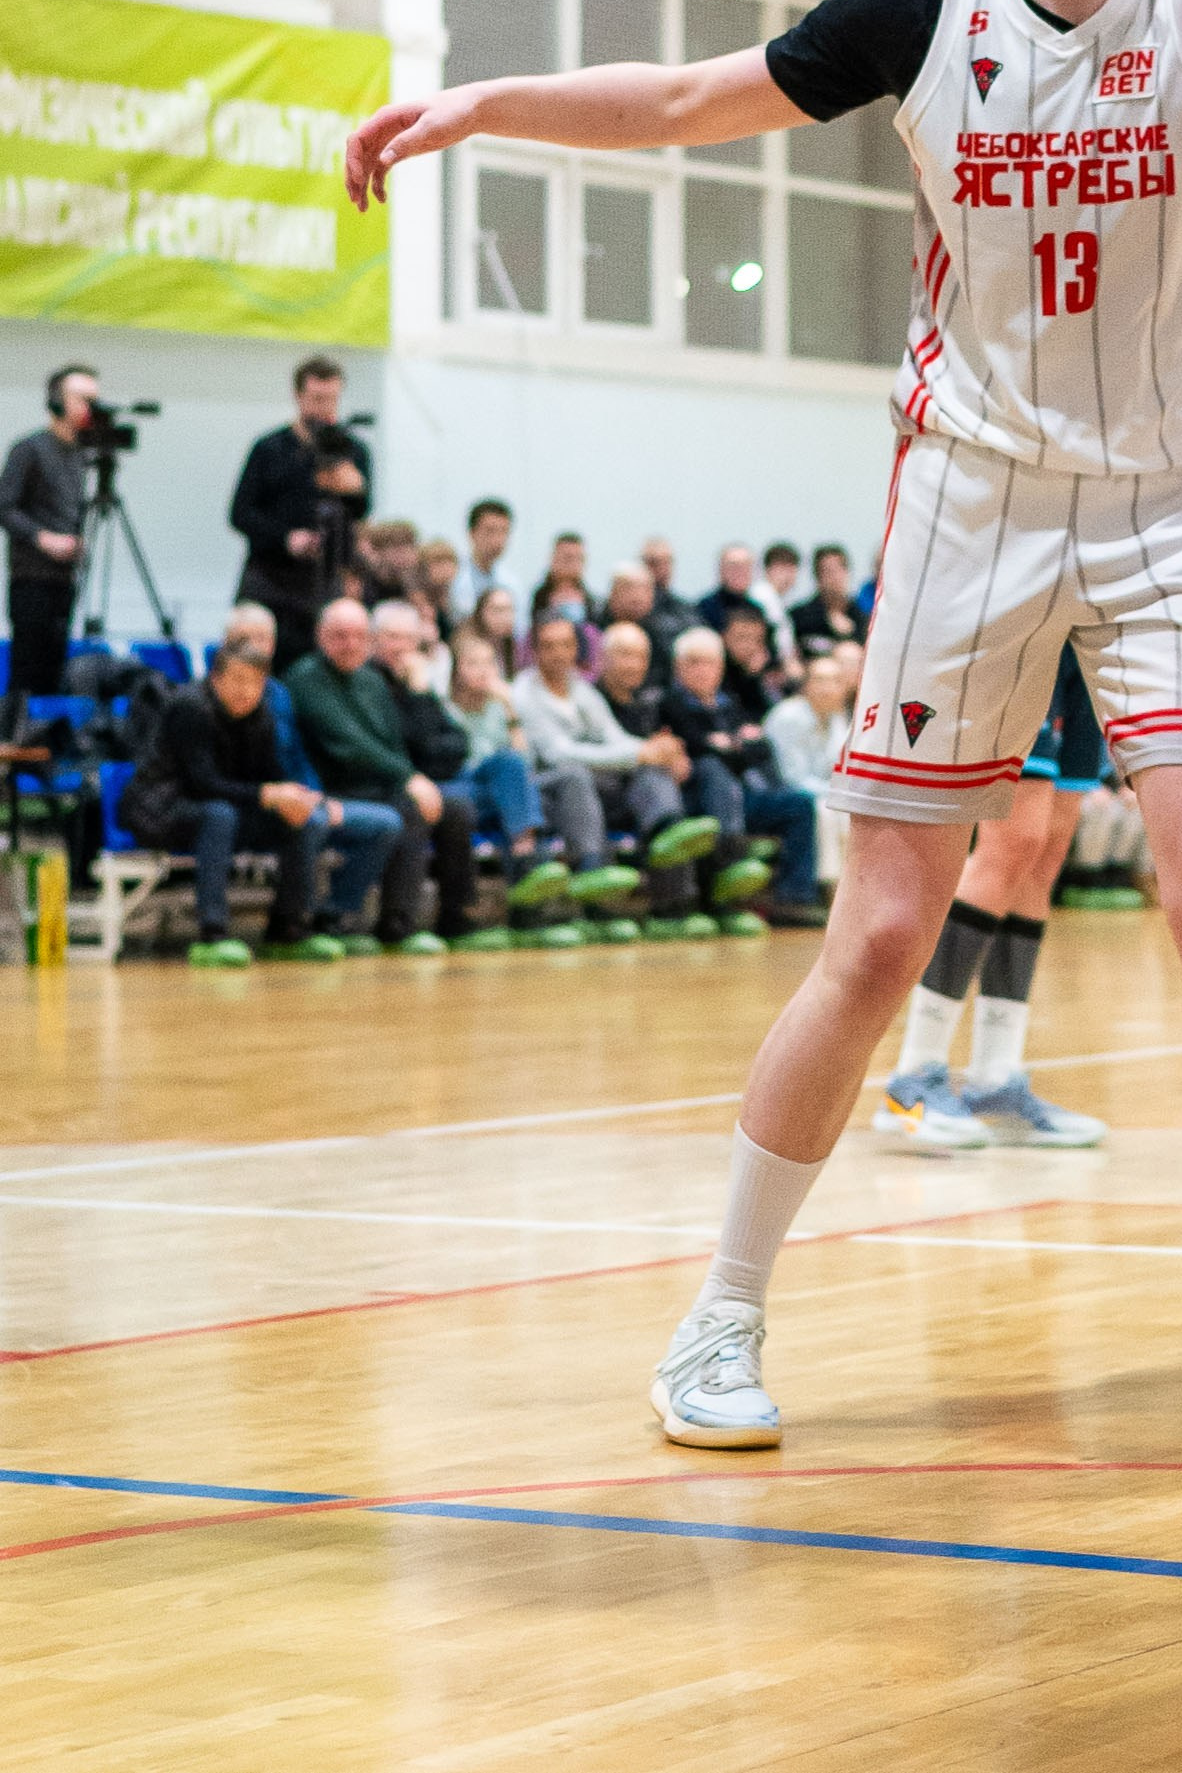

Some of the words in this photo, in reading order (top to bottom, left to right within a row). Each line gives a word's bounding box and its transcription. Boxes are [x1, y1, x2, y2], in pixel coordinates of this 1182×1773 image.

[1102, 50, 1155, 77] FON
[1099, 72, 1151, 97] BET
[956, 124, 1169, 158] ЧЕБОКСАРСКИЕ
[952, 153, 1175, 208] ЯСТРЕБЫ
[1032, 230, 1099, 317] 13
